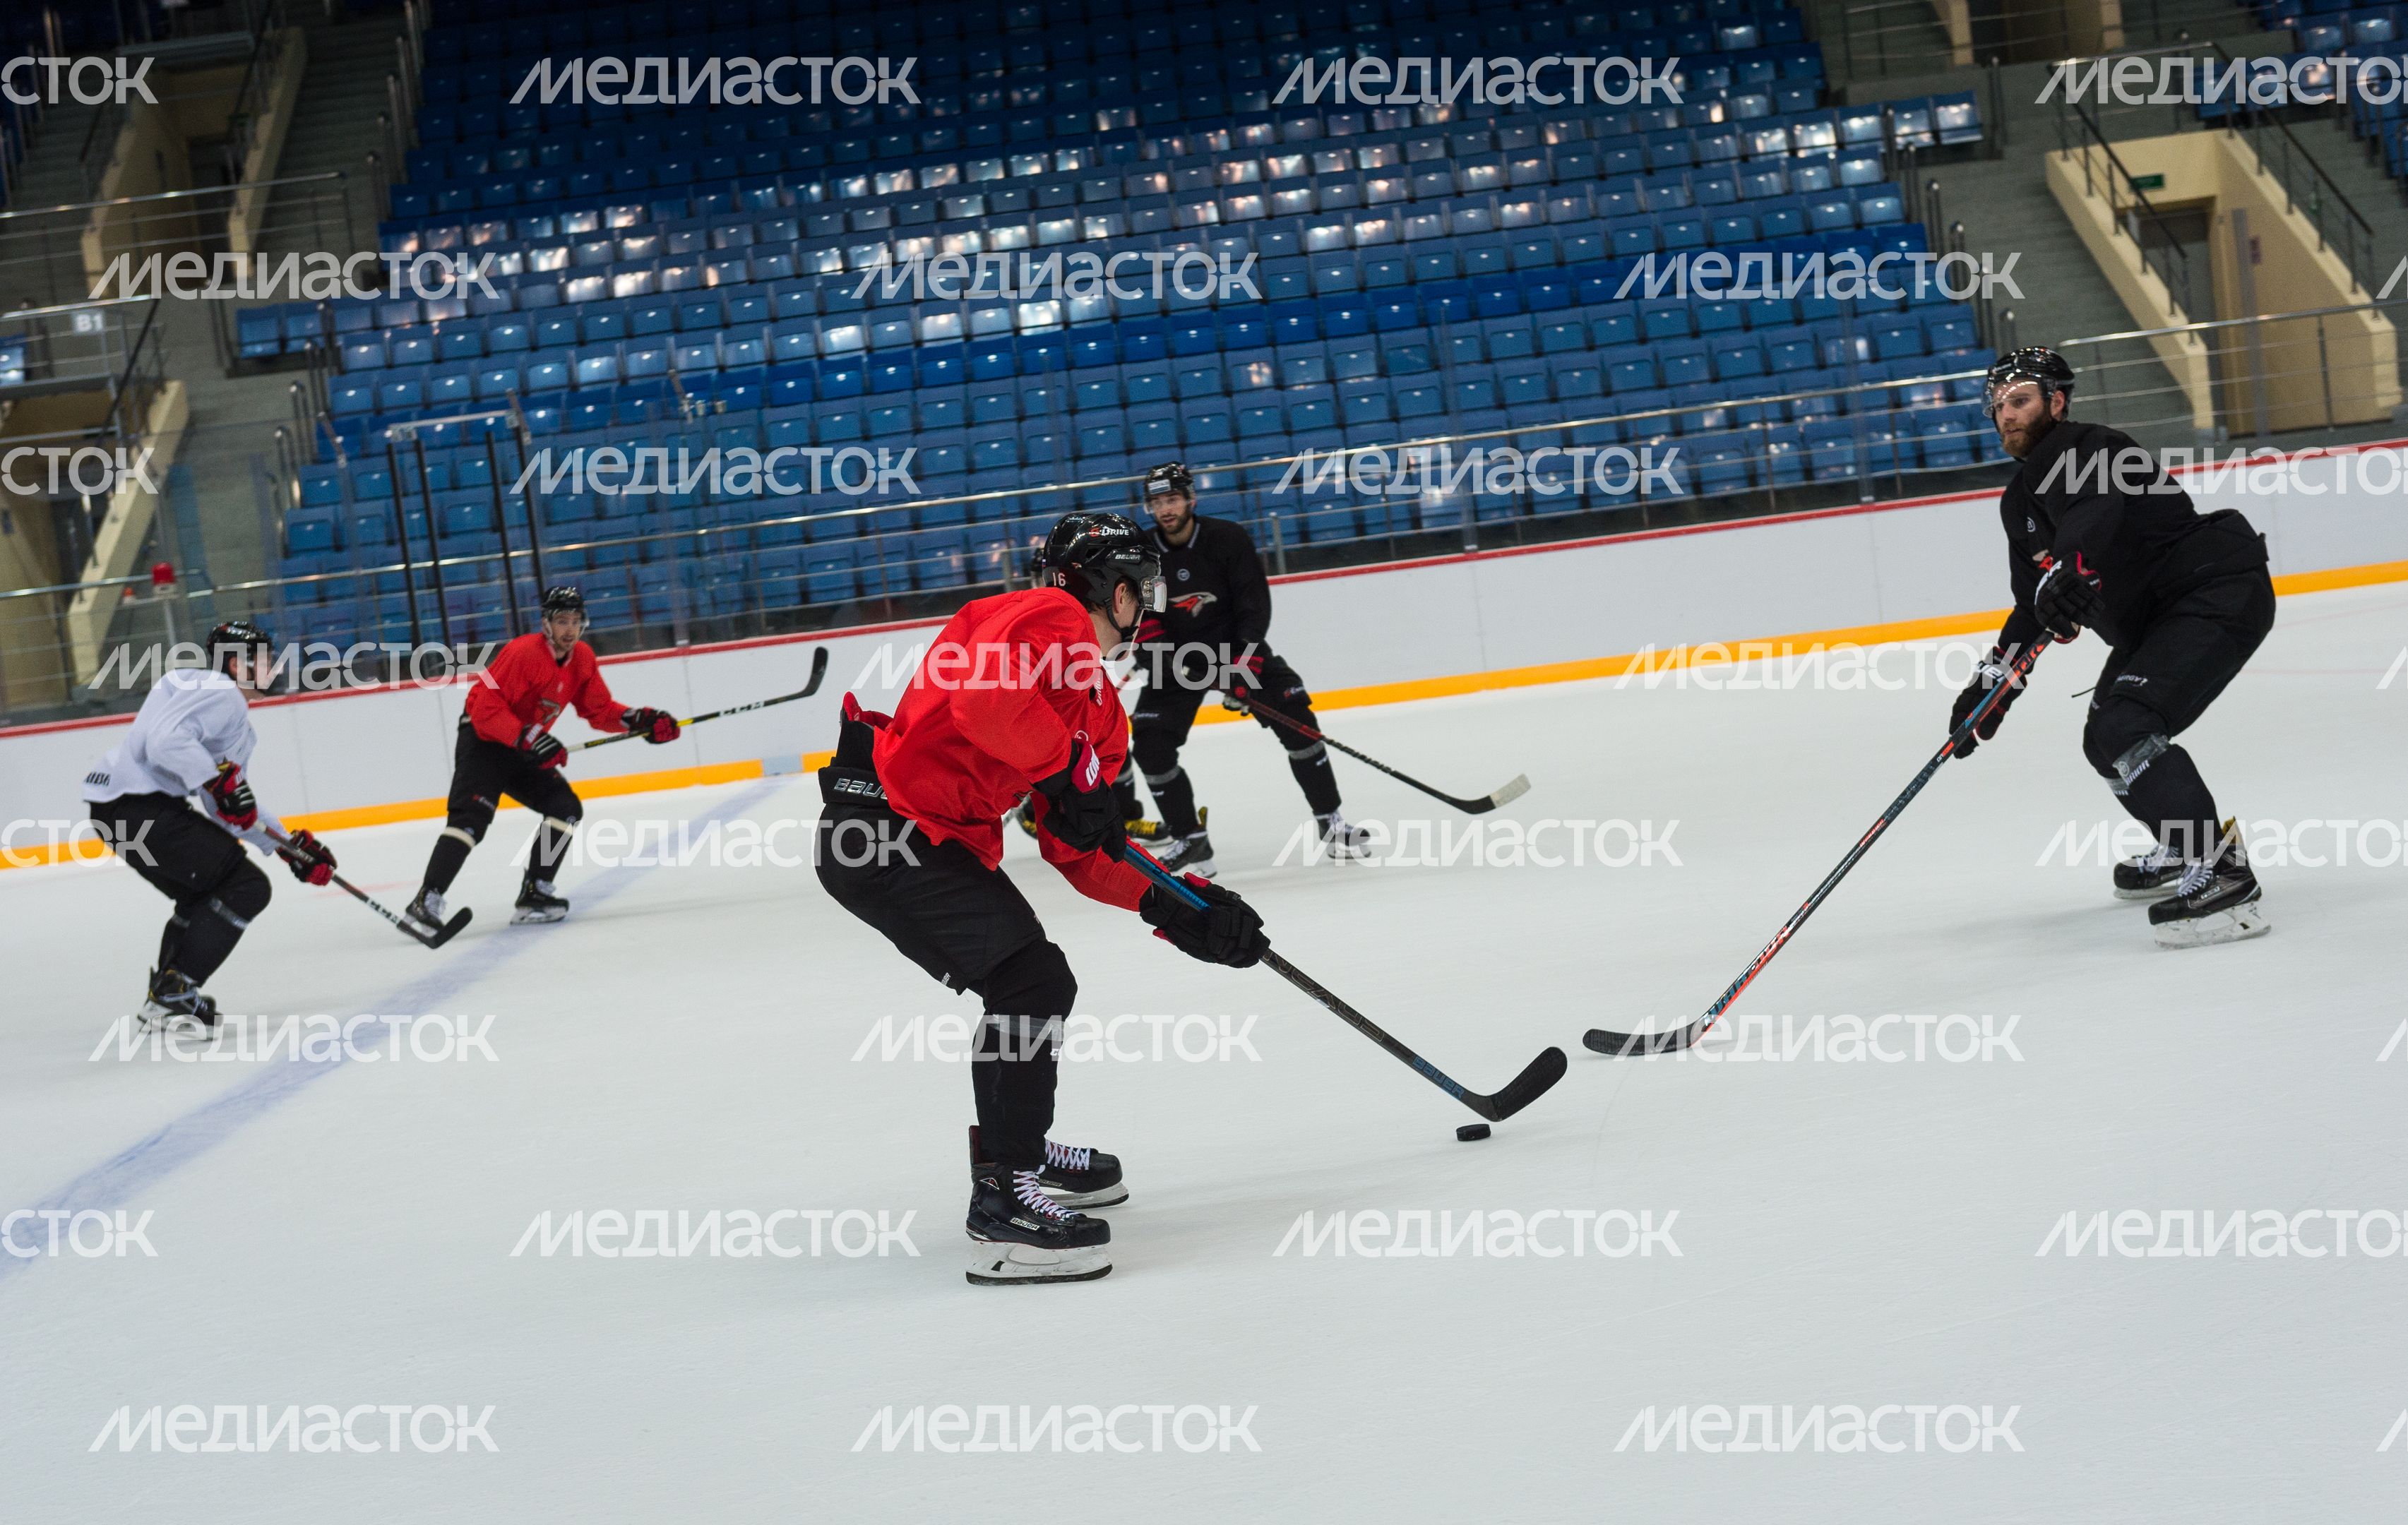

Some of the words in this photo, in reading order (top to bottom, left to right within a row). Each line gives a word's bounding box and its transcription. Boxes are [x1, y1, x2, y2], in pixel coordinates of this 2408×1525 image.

[1052, 572, 1066, 587] 16
[1412, 1055, 1465, 1099] BAUER
[1011, 1218, 1039, 1231] BAUER
